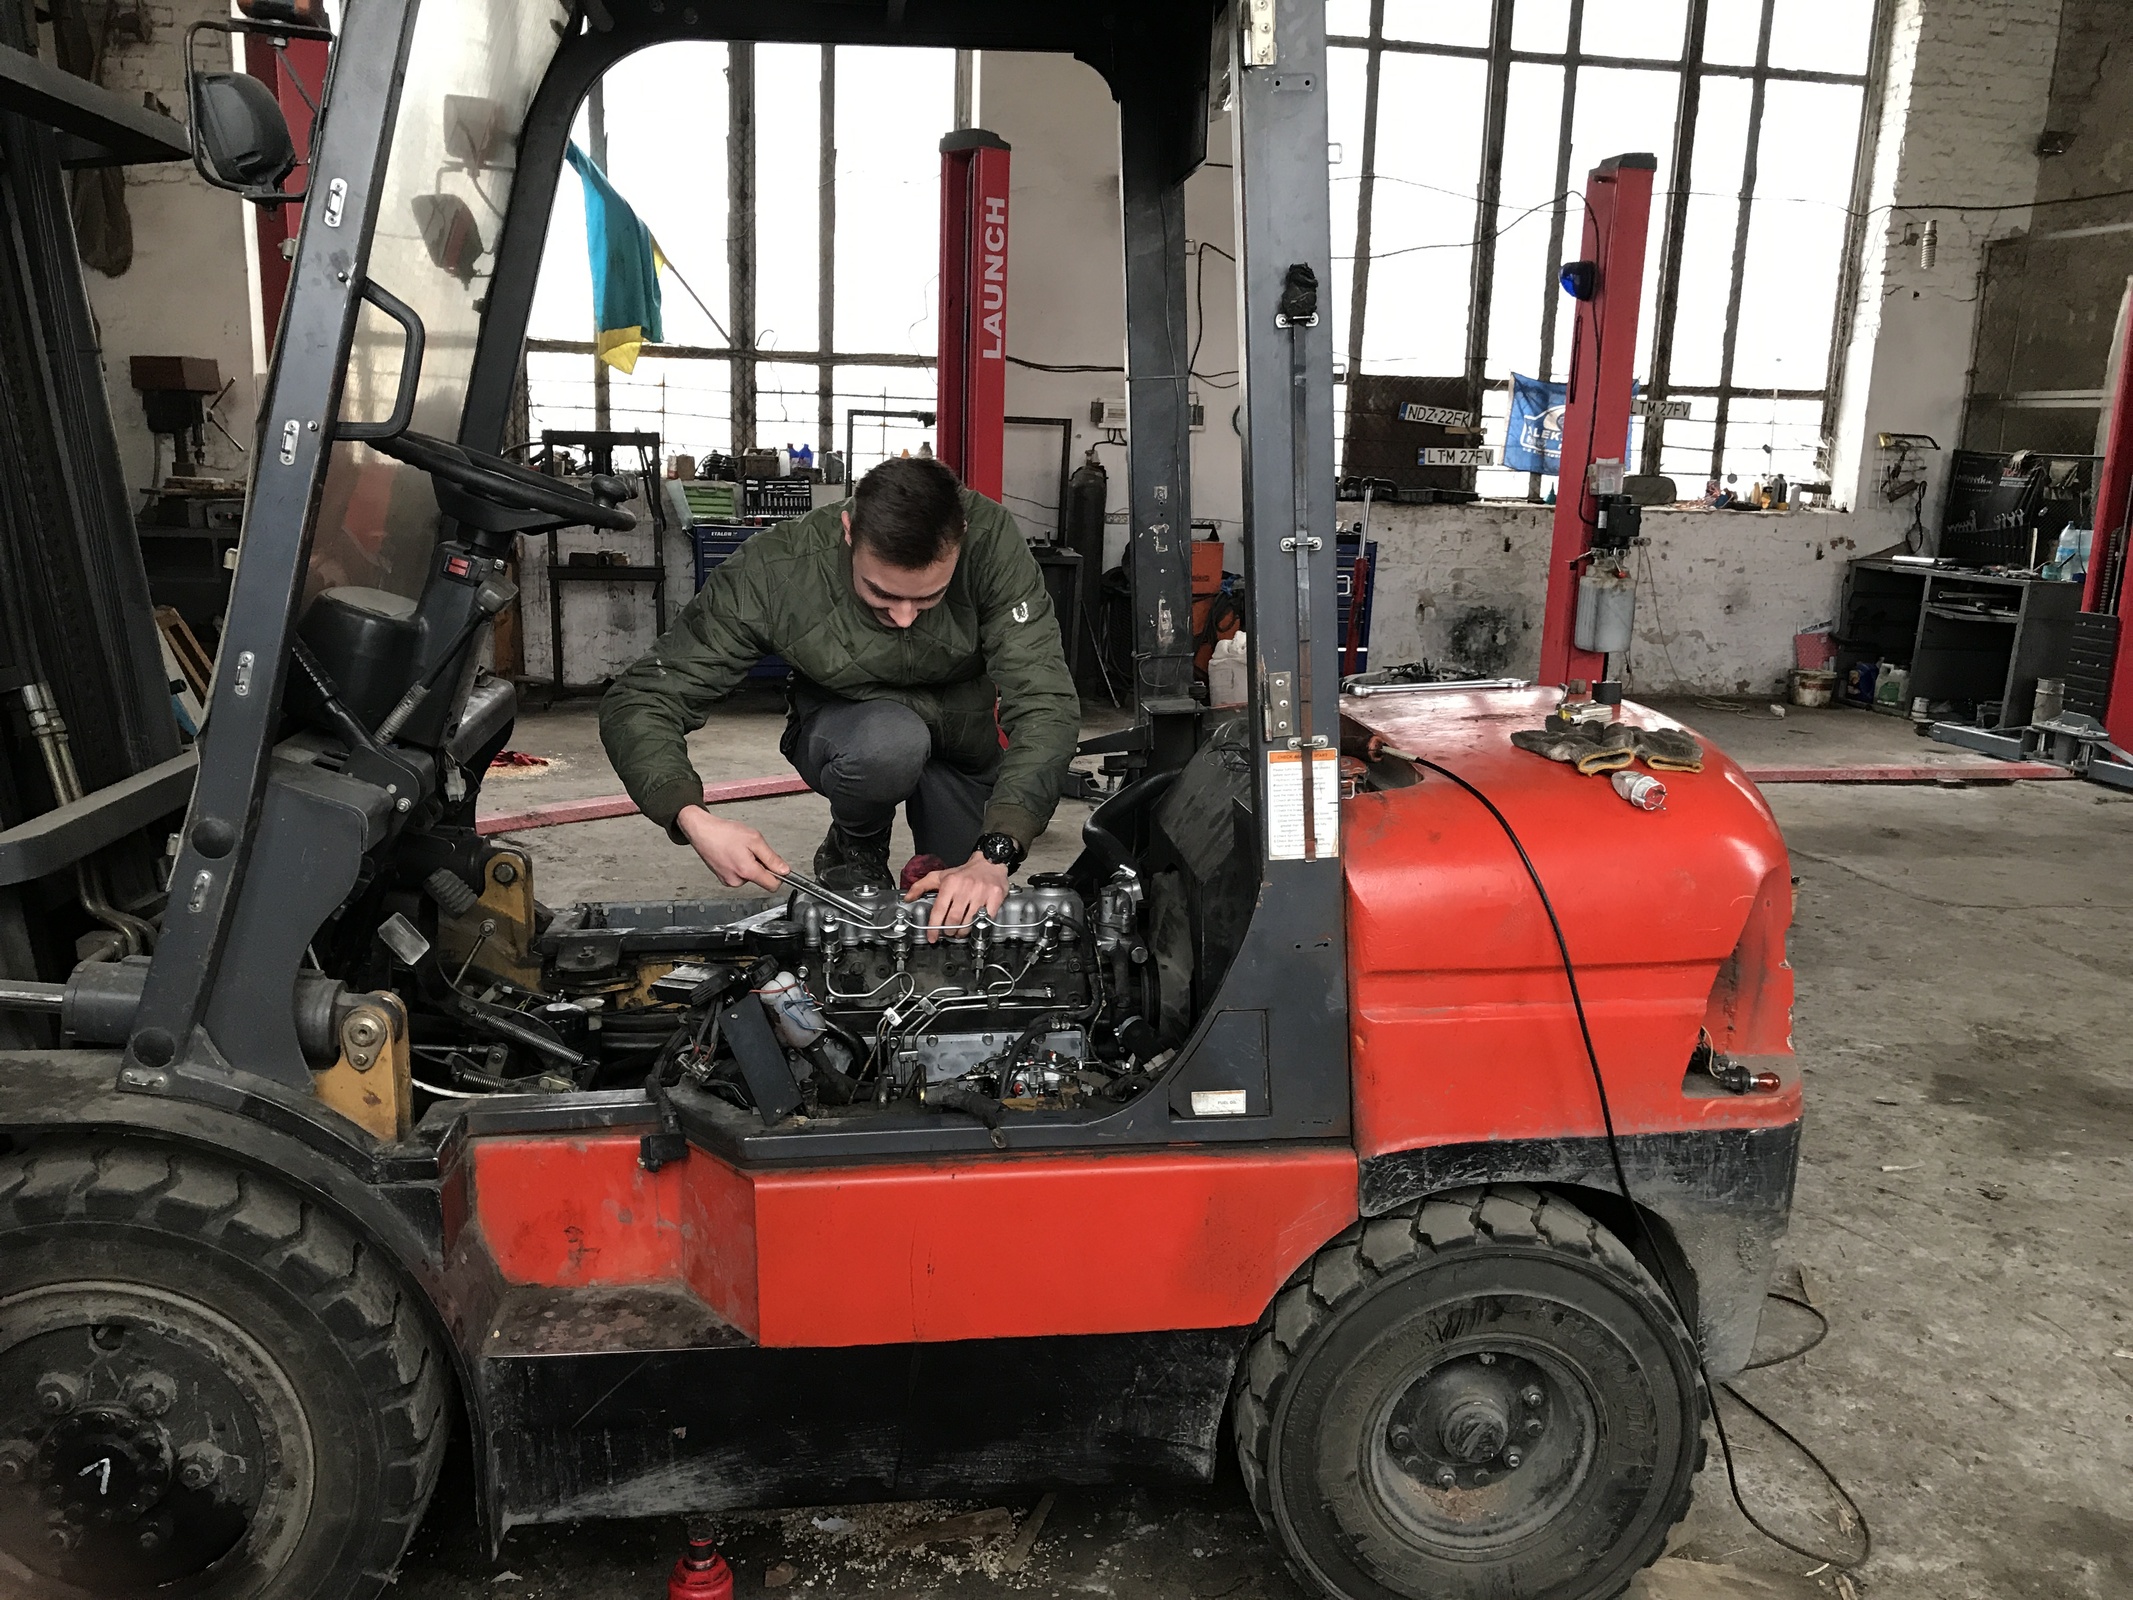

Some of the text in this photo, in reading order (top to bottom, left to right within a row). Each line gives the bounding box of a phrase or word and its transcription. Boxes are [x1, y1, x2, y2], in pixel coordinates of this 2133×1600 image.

[983, 197, 1005, 359] LAUNCH
[1407, 406, 1470, 427] NDZ 22FK
[1630, 401, 1689, 417] LTM 27FV
[1527, 426, 1562, 441] ALEK
[1427, 450, 1493, 464] LTM 27FV
[78, 1457, 110, 1495] 1
